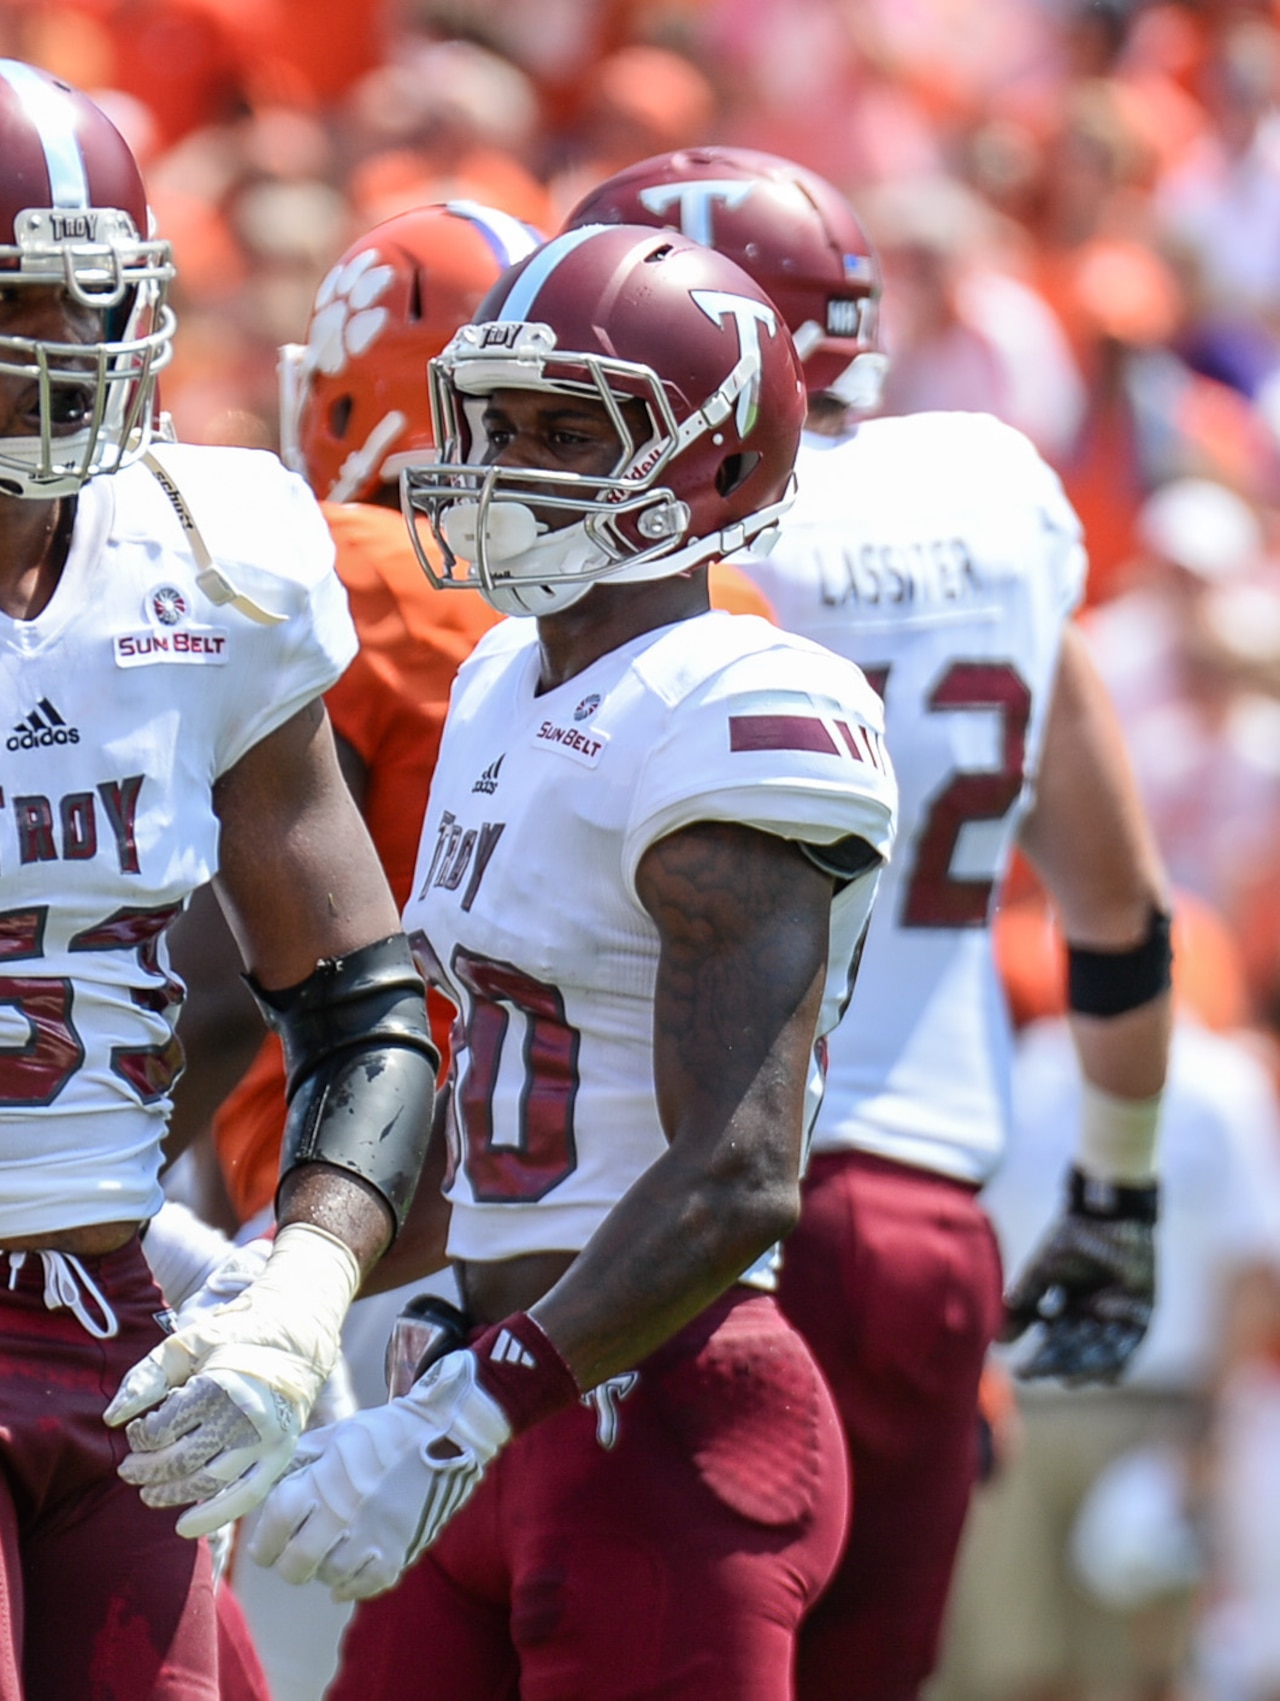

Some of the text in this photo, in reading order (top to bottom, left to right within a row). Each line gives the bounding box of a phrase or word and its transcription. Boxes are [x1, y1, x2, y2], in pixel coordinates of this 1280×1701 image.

[48, 213, 99, 242] TROY
[479, 323, 523, 349] TROY
[119, 631, 226, 656] SUN BELT
[6, 726, 80, 752] adidas
[537, 721, 601, 757] SUN BELT
[418, 810, 506, 914] TROY
